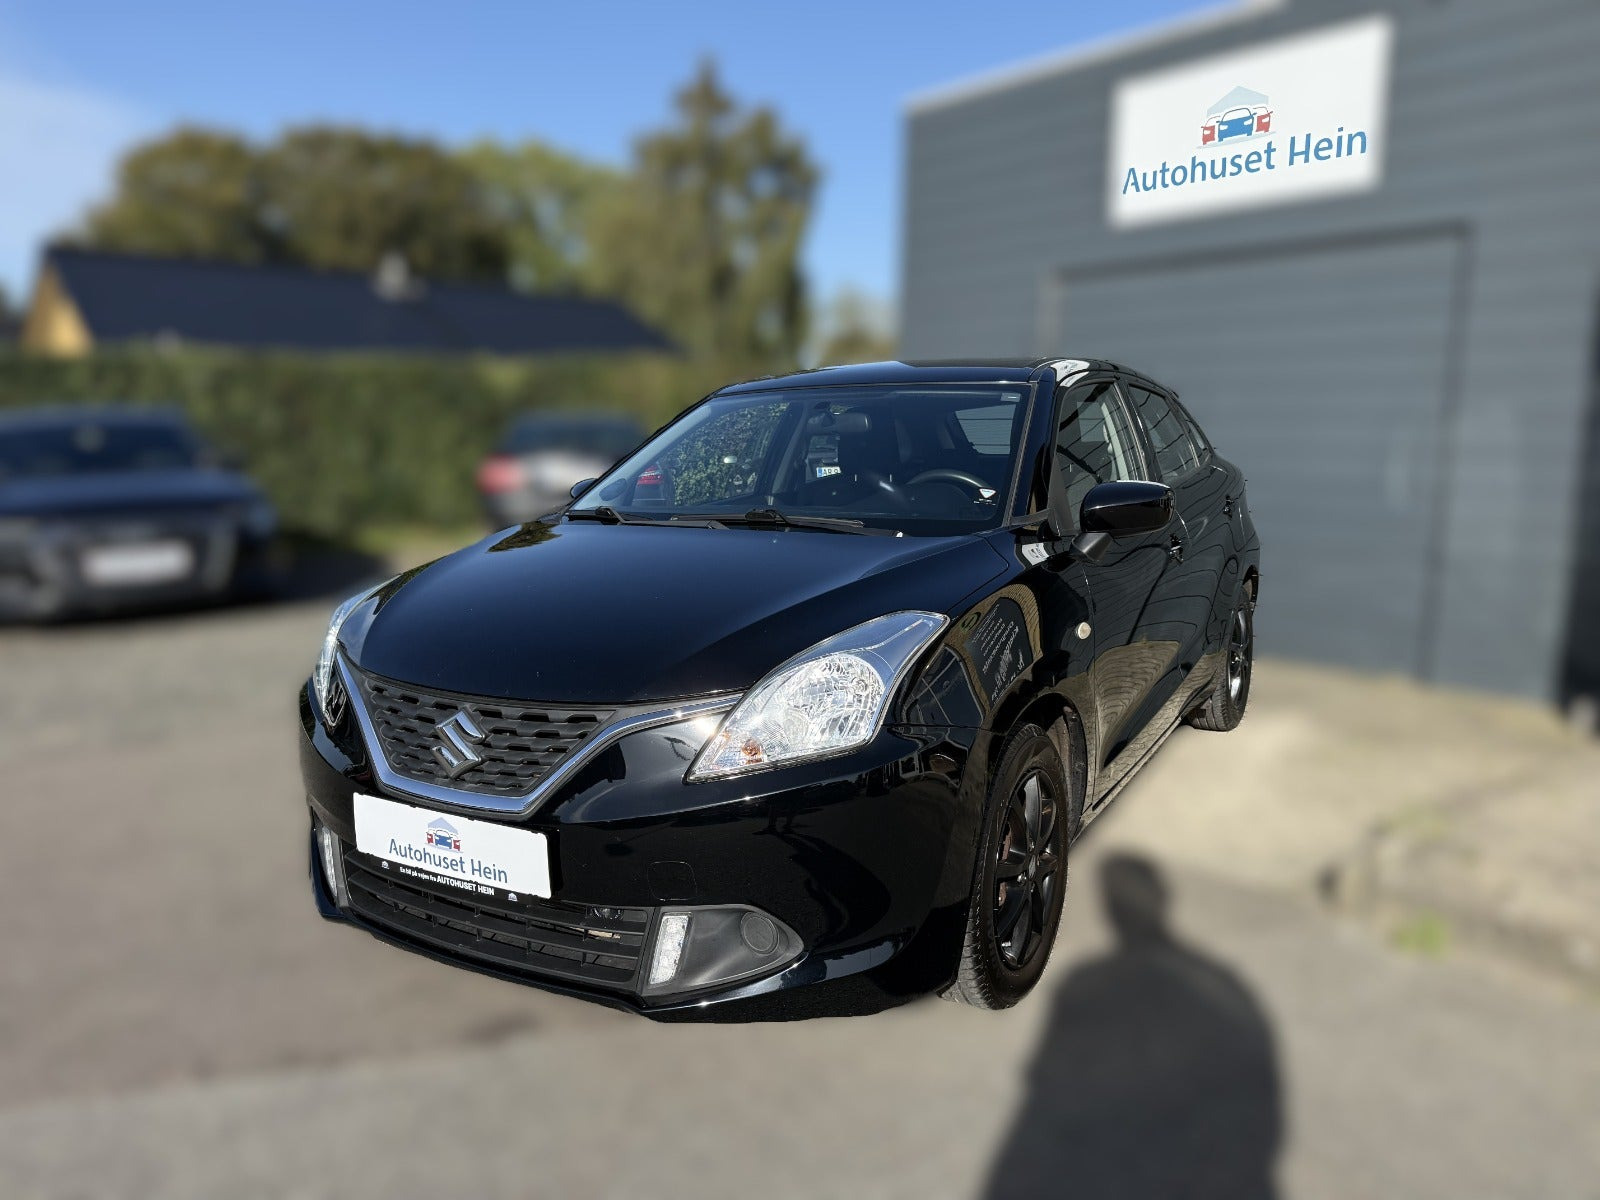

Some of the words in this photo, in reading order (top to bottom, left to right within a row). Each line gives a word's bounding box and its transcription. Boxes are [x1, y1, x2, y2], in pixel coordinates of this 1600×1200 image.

[1122, 141, 1276, 195] Autohuset
[1288, 126, 1367, 167] Hein
[389, 838, 466, 874] Autohuset
[470, 858, 508, 884] Hein
[437, 876, 476, 892] AUTOHUSET
[477, 884, 495, 896] HEIN
